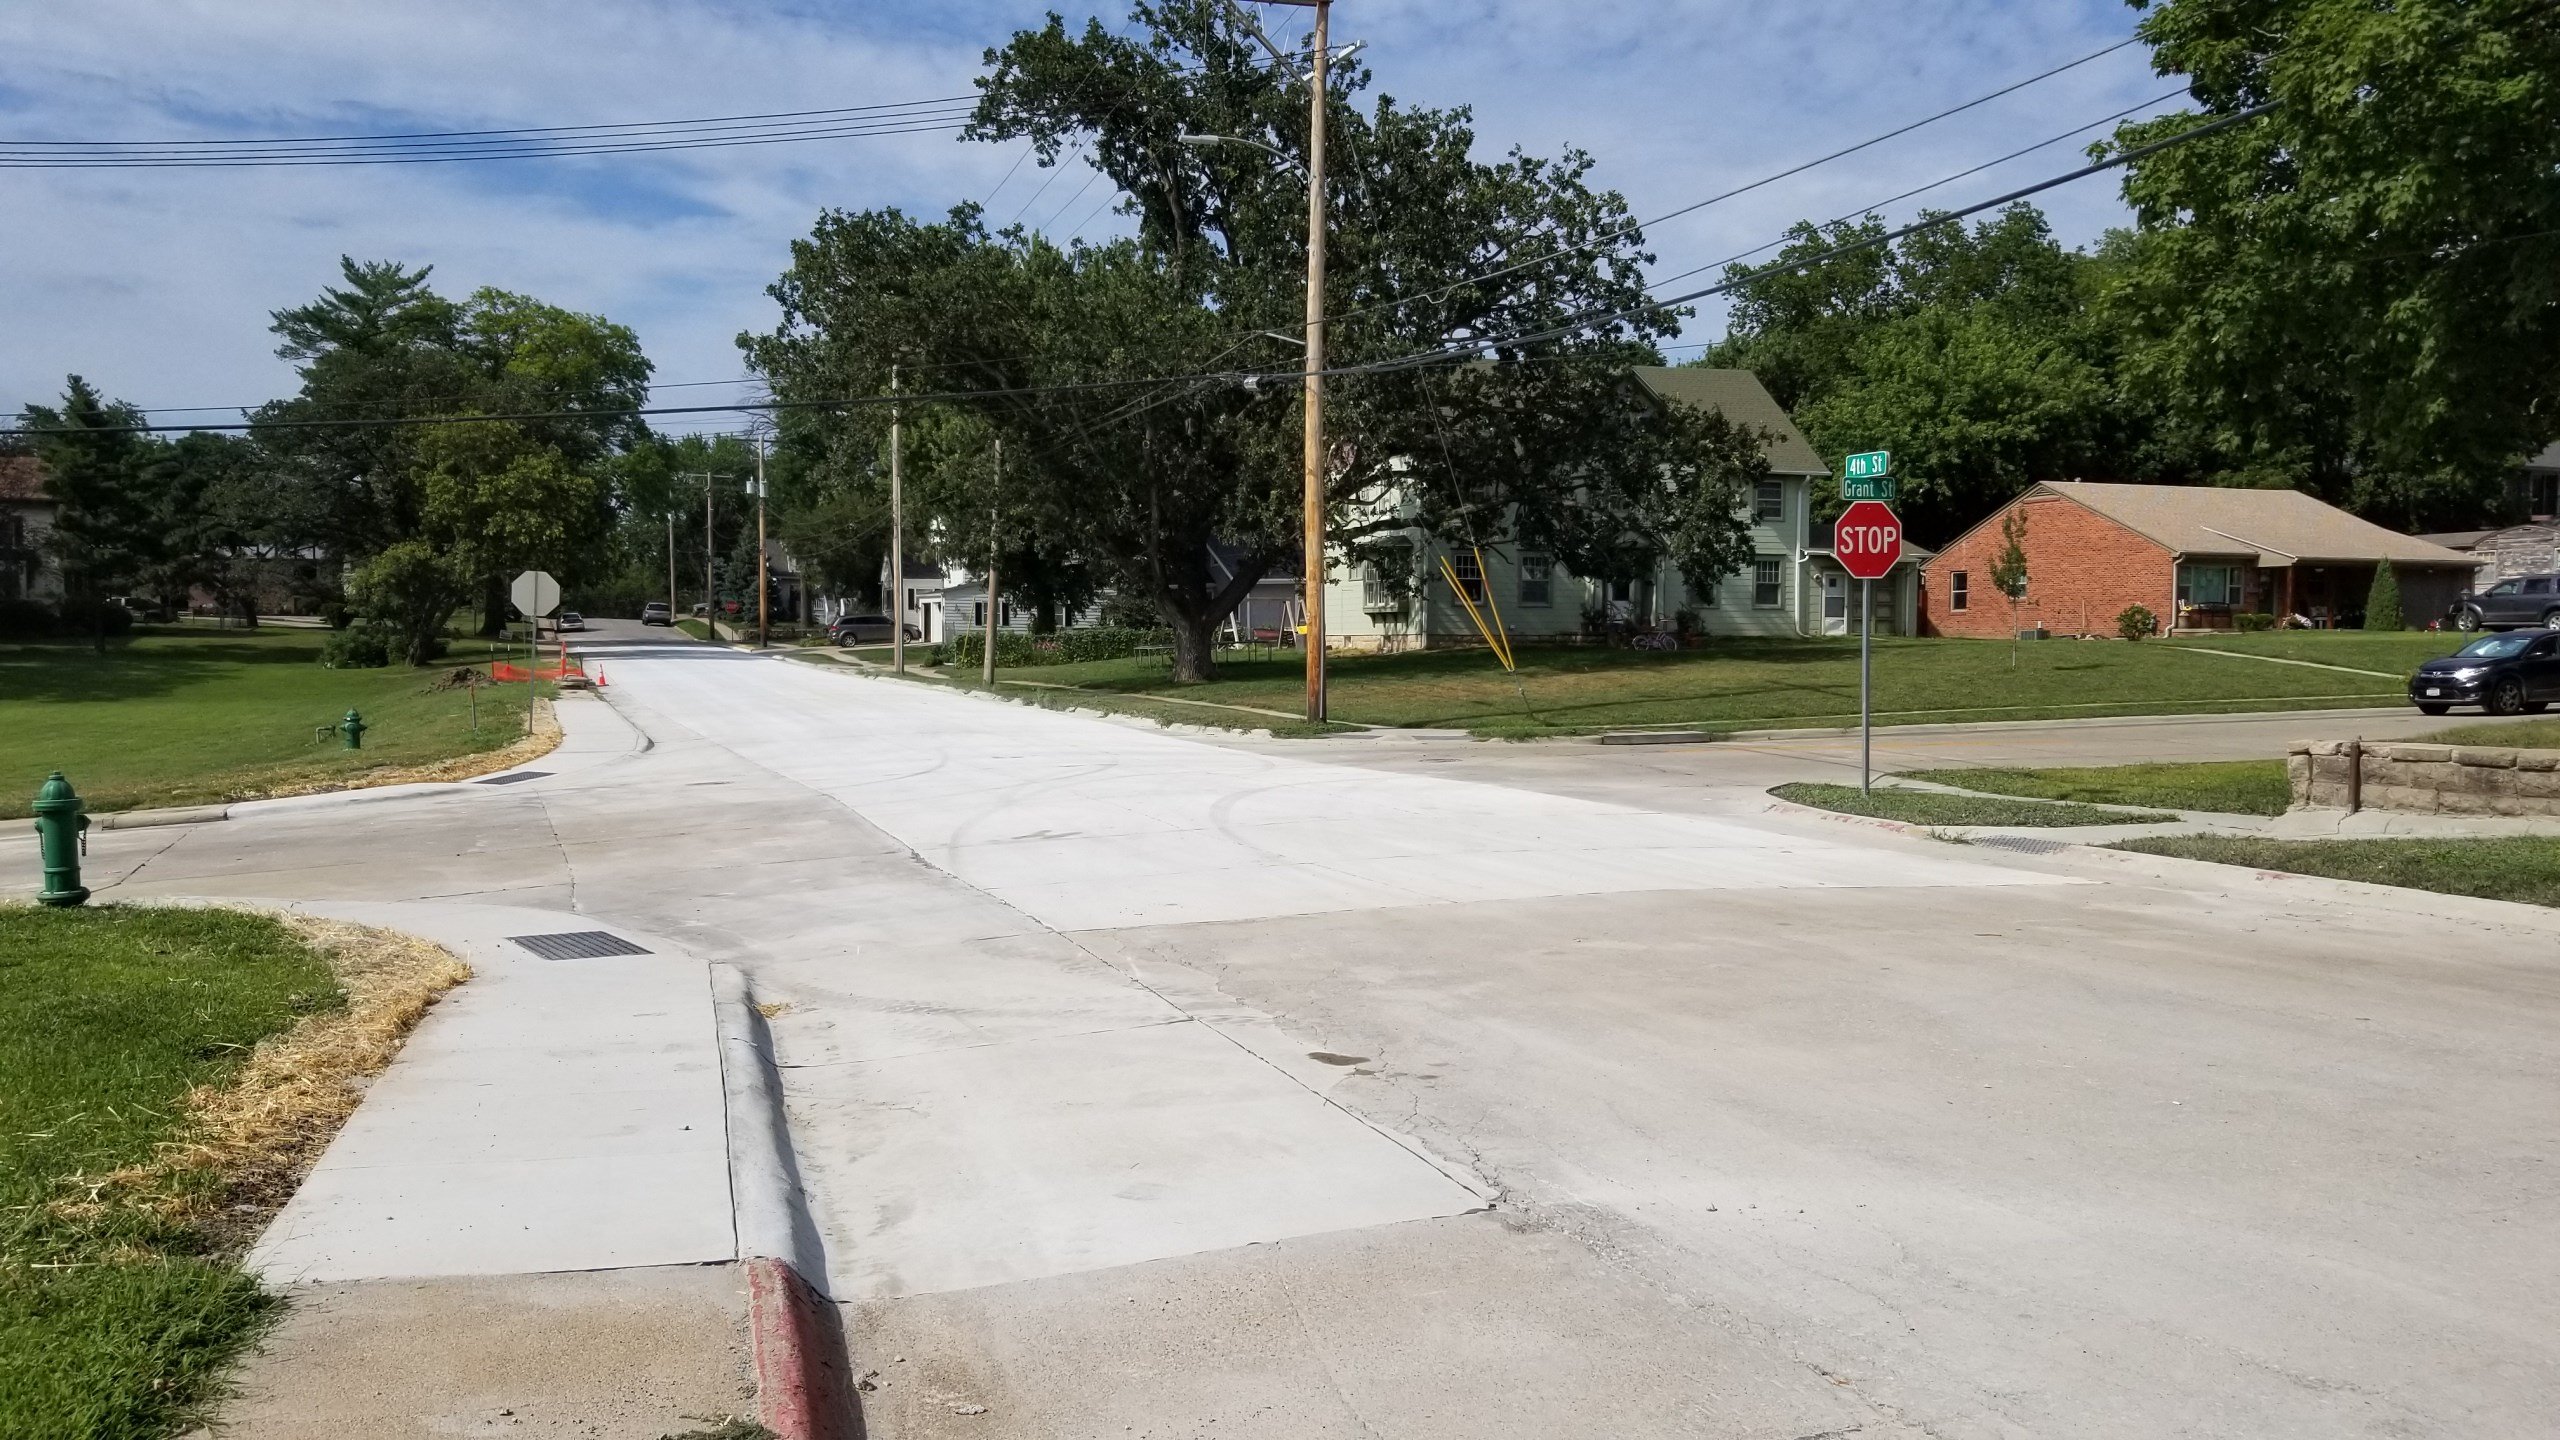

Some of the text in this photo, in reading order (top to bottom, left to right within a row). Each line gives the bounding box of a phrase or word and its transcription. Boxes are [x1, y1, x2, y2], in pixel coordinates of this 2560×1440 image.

[1850, 455, 1882, 475] 4th St
[1844, 480, 1893, 497] Grant St
[1840, 526, 1897, 554] STOP
